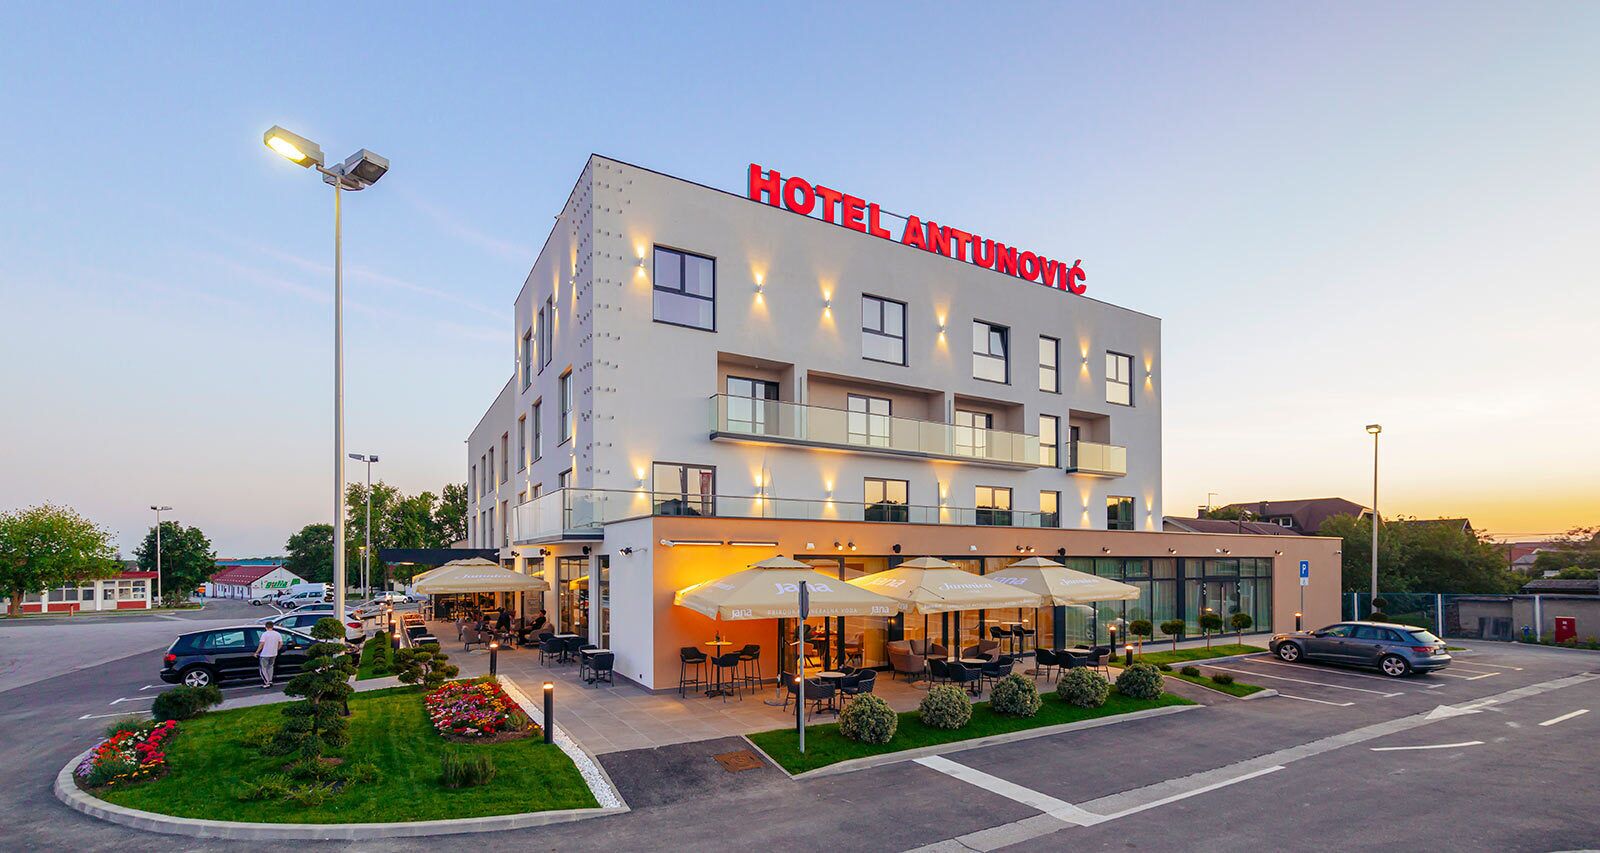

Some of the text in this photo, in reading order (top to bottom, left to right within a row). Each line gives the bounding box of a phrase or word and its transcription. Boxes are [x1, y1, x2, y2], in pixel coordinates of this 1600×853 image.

[748, 162, 1087, 295] HOTEL ANTUNOVIĆ
[1302, 563, 1307, 574] P
